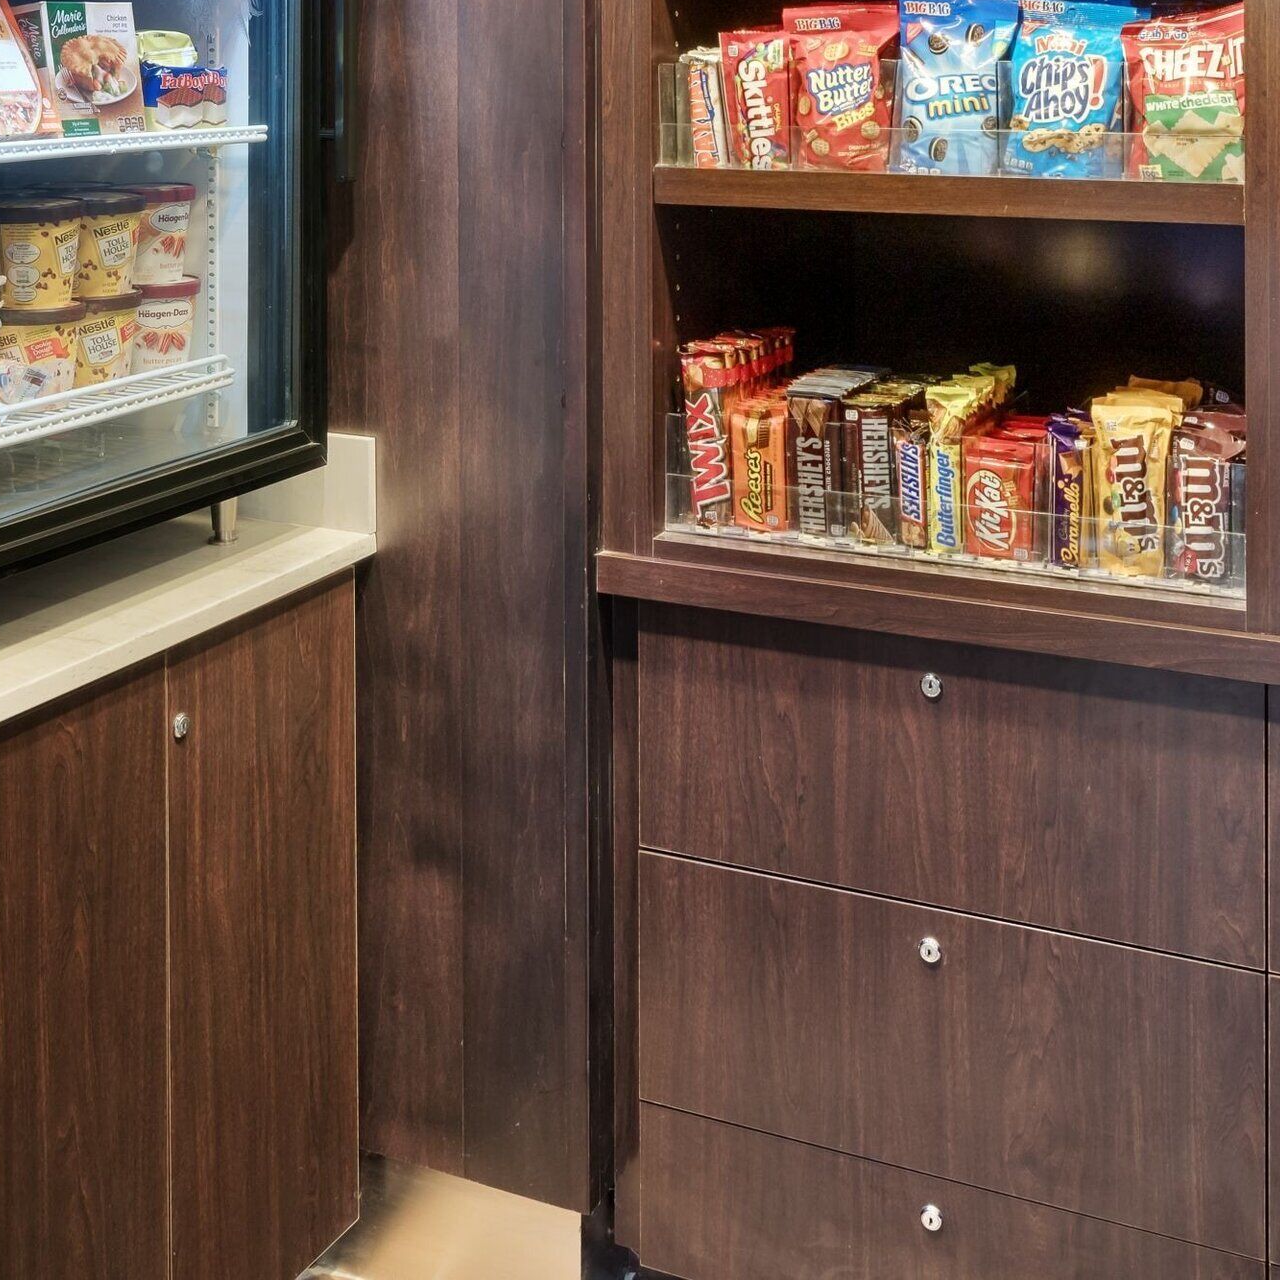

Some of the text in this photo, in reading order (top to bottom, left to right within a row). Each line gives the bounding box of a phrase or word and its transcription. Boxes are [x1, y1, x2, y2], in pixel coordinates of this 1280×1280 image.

[51, 10, 84, 27] Marie
[904, 1, 951, 16] BIG BAG
[1018, 0, 1064, 14] BIG BAG
[794, 17, 841, 31] BIG BAG
[1035, 36, 1085, 56] Mini
[809, 65, 872, 93] Nutter
[907, 74, 997, 100] OREO
[1020, 57, 1089, 97] Chips
[816, 76, 873, 112] Butter
[928, 95, 990, 119] mini
[1181, 95, 1234, 110] cheddar
[738, 60, 775, 171] Skittles
[832, 102, 875, 132] Bites
[103, 242, 130, 257] HOUSE
[105, 237, 126, 248] TOLL
[138, 307, 189, 319] Häagen-Dazs
[87, 339, 118, 353] HOUSE
[91, 334, 112, 346] TOLL
[685, 392, 731, 518] TWIX
[823, 439, 831, 472] chocolate
[861, 417, 891, 510] HERSHEY'S
[739, 447, 763, 525] Reese's
[796, 436, 827, 535] HERSHEY'S
[898, 442, 922, 522] SATISFIES
[935, 450, 957, 548] Butterfinger
[1060, 481, 1081, 565] Caramello
